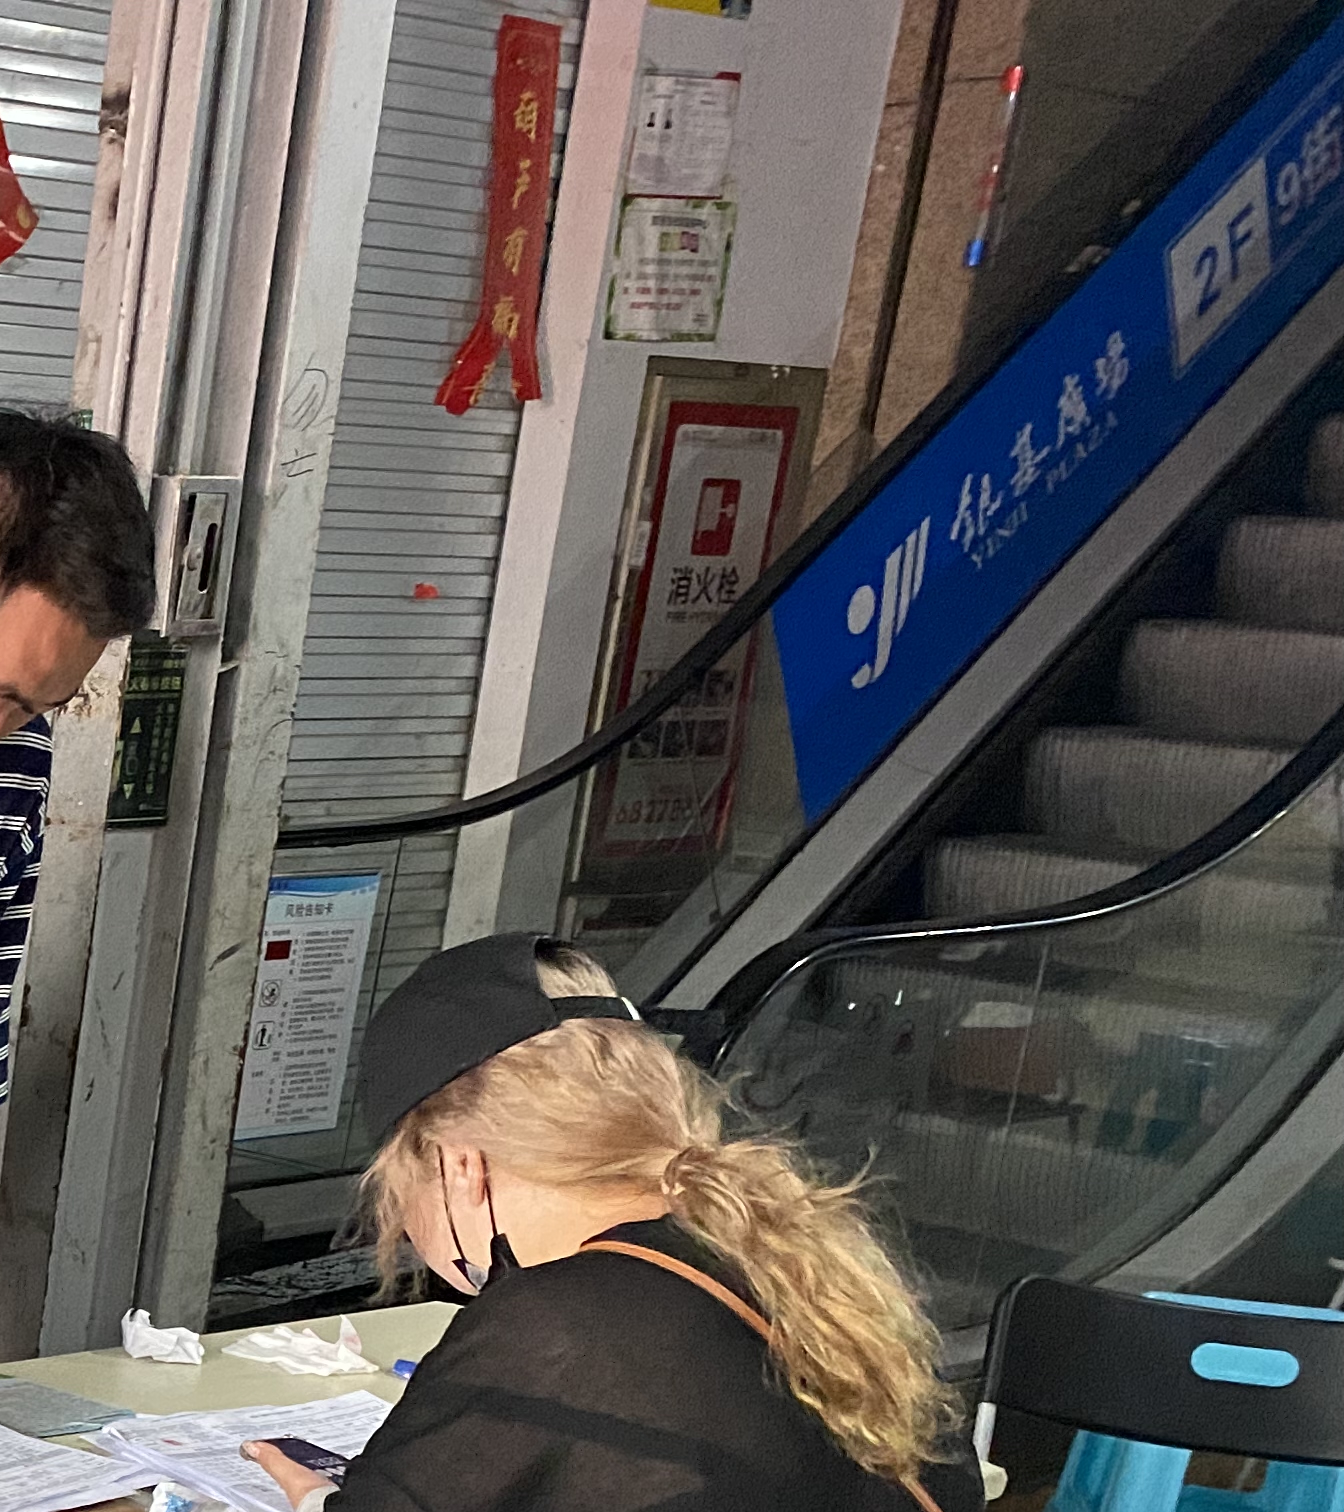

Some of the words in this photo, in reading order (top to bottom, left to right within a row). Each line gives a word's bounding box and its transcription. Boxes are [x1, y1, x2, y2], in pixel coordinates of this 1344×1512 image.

[1194, 202, 1255, 316] 2F
[666, 566, 740, 606] 消火栓
